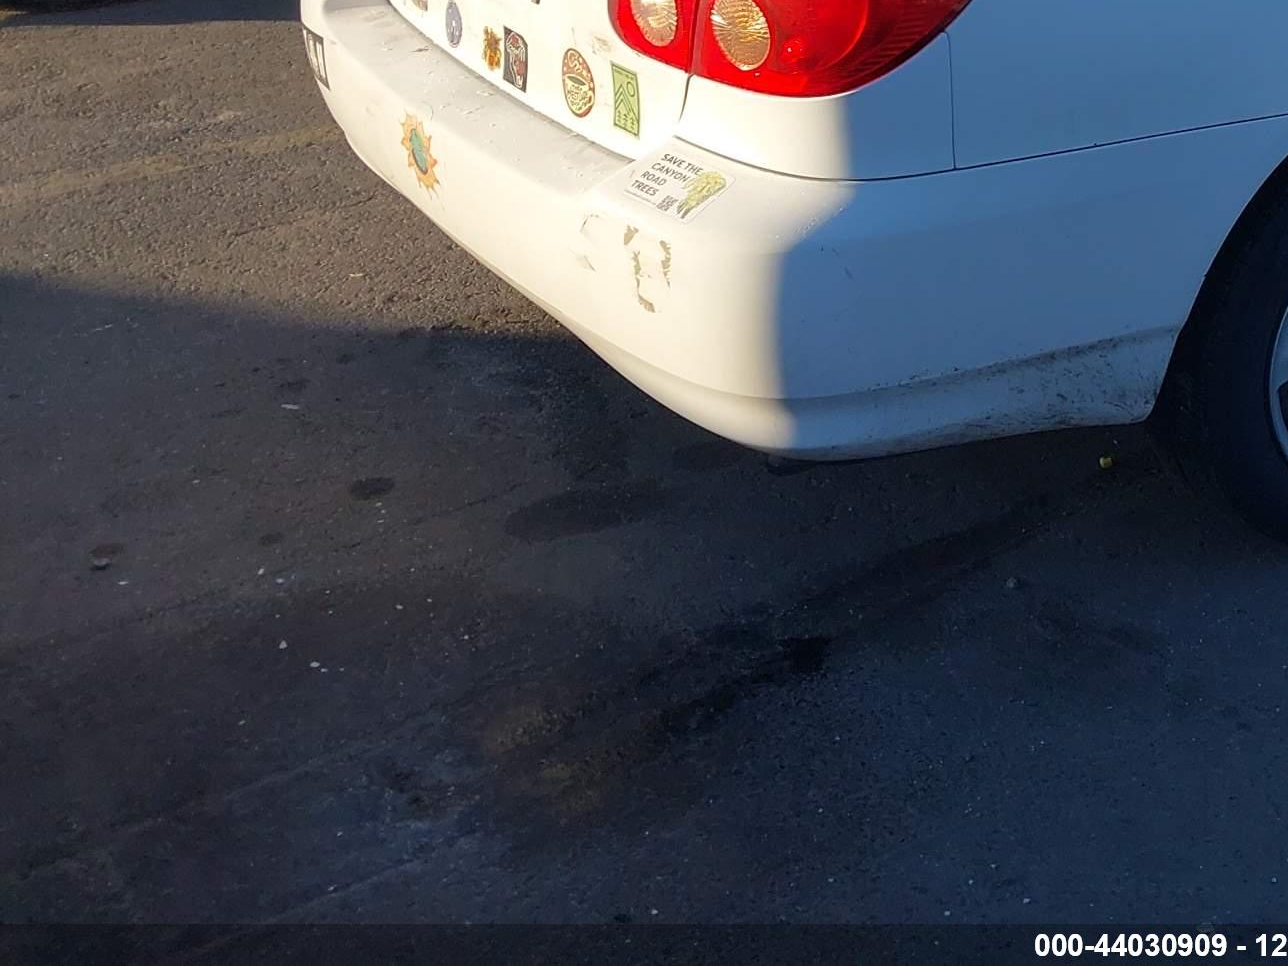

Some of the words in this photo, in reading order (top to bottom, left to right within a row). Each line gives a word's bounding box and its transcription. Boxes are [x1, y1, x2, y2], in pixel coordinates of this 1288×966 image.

[651, 162, 692, 183] CANYON
[661, 153, 685, 168] SAVE
[684, 163, 704, 176] THE
[640, 170, 667, 186] ROAD
[631, 179, 660, 197] TREES
